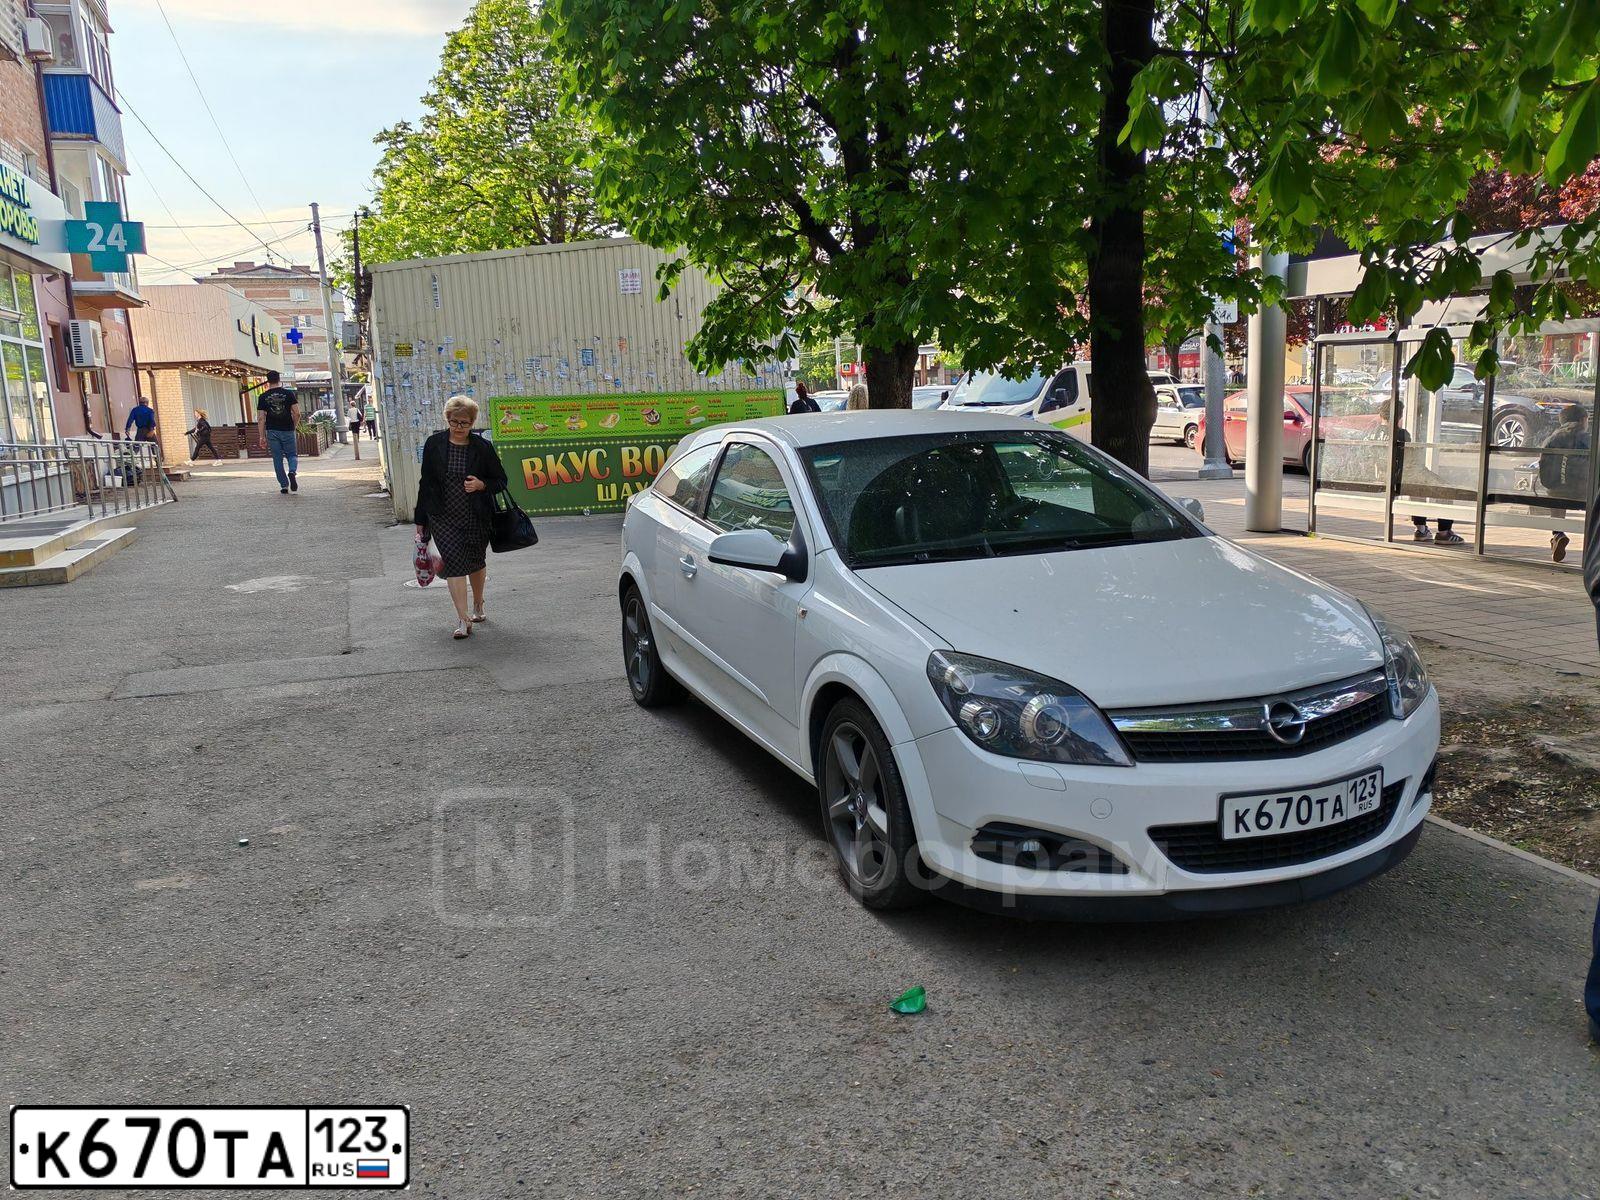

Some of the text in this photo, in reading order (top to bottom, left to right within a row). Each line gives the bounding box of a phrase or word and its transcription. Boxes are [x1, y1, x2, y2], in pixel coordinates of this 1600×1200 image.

[85, 222, 128, 252] 24
[521, 448, 610, 491] ВКУС
[1234, 774, 1377, 834] К670ТА 123
[1358, 800, 1373, 811] RUS
